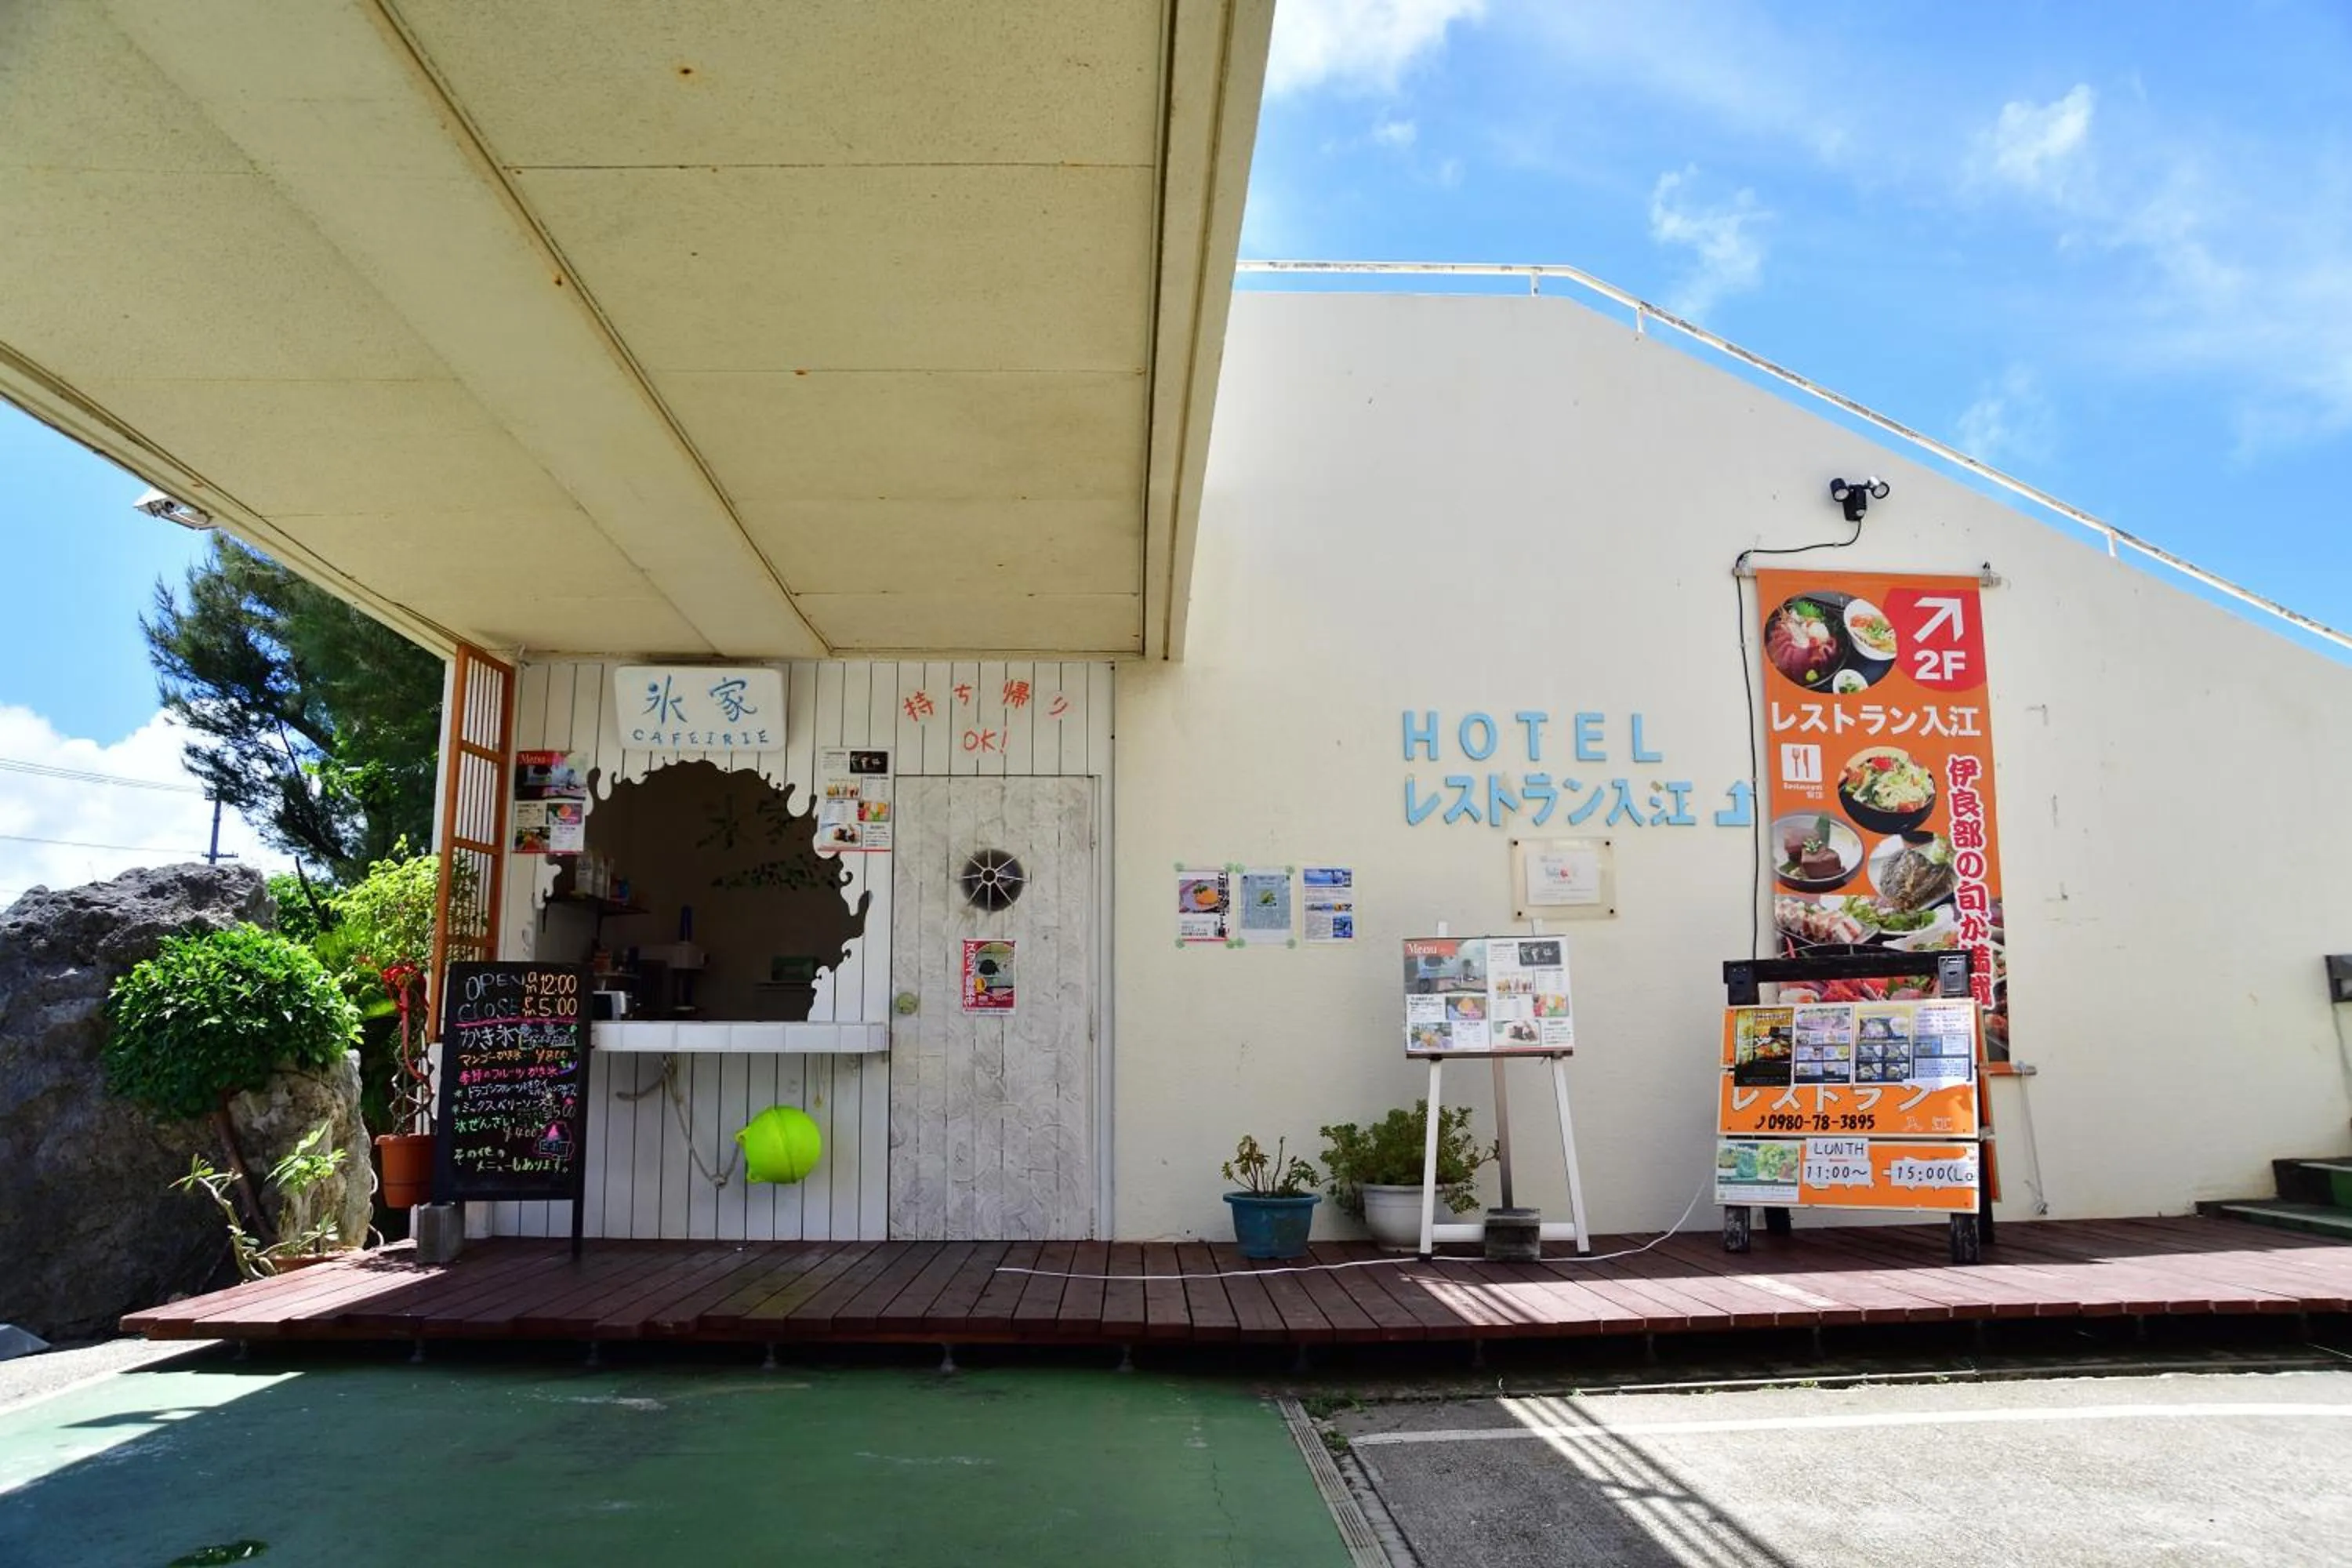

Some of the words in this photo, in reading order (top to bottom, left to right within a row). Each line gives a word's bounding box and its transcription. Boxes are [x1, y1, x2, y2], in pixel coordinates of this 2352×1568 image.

[1913, 649, 1966, 681] 2F
[1770, 702, 1982, 738] レストラン入江
[1403, 710, 1663, 763] HOTEL
[1405, 773, 1697, 827] レストラン入江
[465, 972, 524, 1001] OPEN
[538, 996, 578, 1017] 5:00
[460, 1023, 514, 1051] かき氷
[1767, 1114, 1876, 1131] 0980-78-3895
